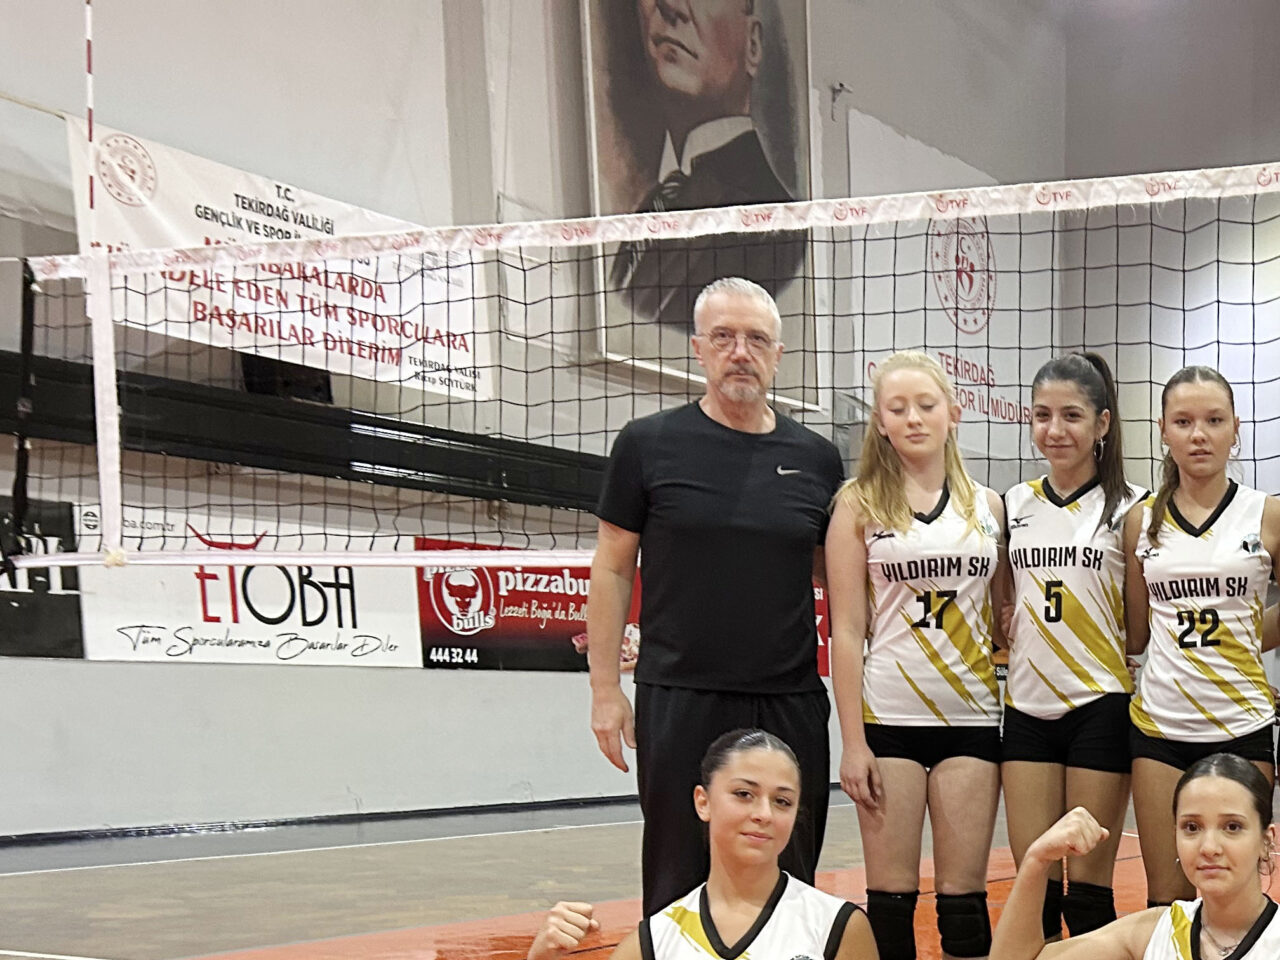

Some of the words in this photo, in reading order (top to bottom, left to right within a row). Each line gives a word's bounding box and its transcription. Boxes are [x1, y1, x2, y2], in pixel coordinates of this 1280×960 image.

[275, 184, 295, 202] T.C.
[950, 199, 969, 208] TVF
[1052, 191, 1072, 201] TVF
[234, 192, 289, 223] TEKİRDAĞ
[245, 218, 261, 235] VE
[193, 300, 316, 347] BAŞARILAR
[322, 330, 401, 366] DİLERİM
[297, 292, 339, 323] TÜM
[347, 306, 470, 353] SPORCULARA
[938, 352, 996, 387] TEKİRDAĞ
[990, 395, 1033, 425] MÜDÜR
[881, 557, 962, 582] YILDIRIM
[967, 556, 990, 578] SK
[1011, 546, 1077, 570] YILDIRIM
[1082, 547, 1104, 571] SK
[497, 565, 591, 596] pizzabu
[1149, 577, 1220, 602] YILDIRIM
[1225, 576, 1248, 598] SK
[911, 589, 958, 630] 17
[1044, 580, 1063, 623] 5
[452, 611, 496, 632] bulls
[1177, 608, 1221, 649] 22
[429, 648, 450, 663] 444
[451, 648, 464, 663] 32
[464, 648, 479, 663] 44
